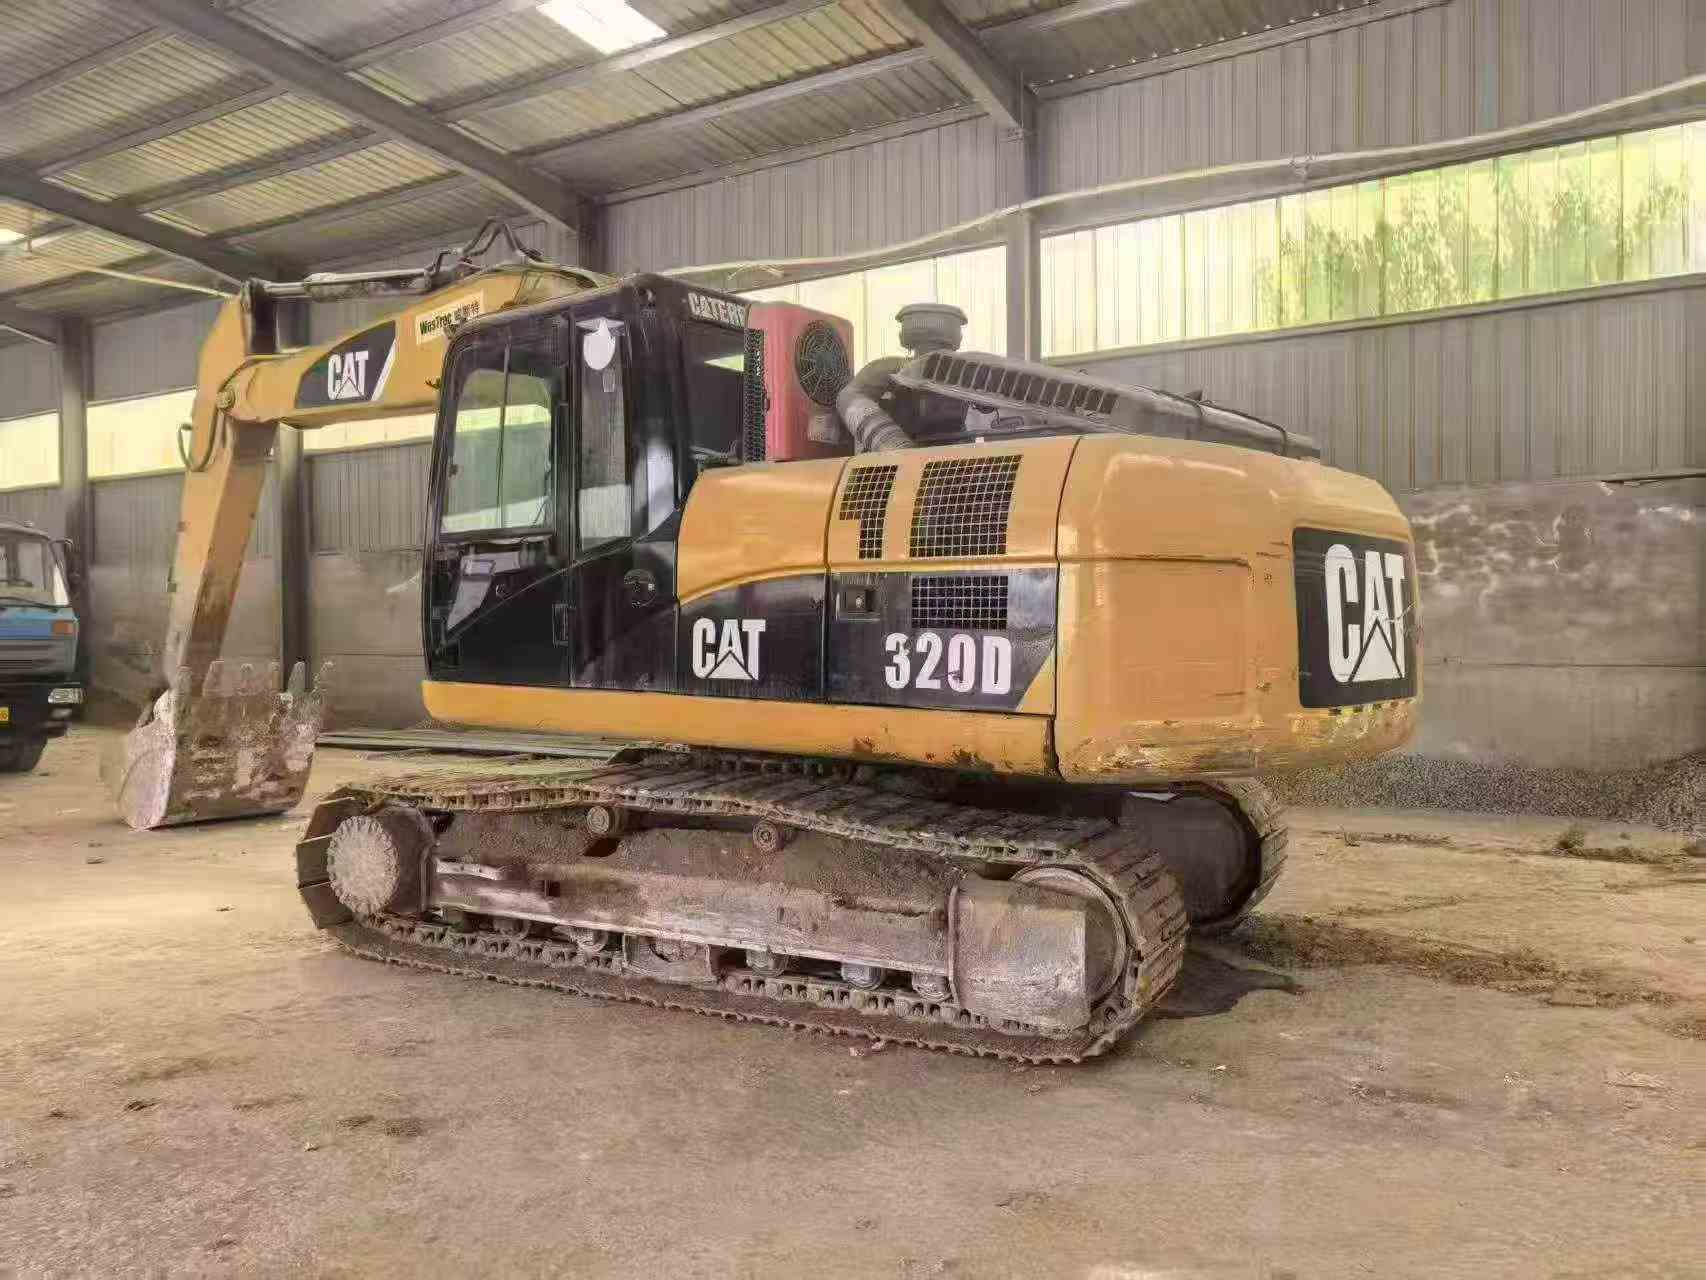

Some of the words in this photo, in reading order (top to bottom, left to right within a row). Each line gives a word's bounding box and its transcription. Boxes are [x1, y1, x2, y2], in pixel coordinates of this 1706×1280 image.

[327, 351, 369, 401] CAT
[1324, 543, 1406, 683] CAT
[692, 617, 766, 681] CAT
[885, 632, 1012, 694] 320D
